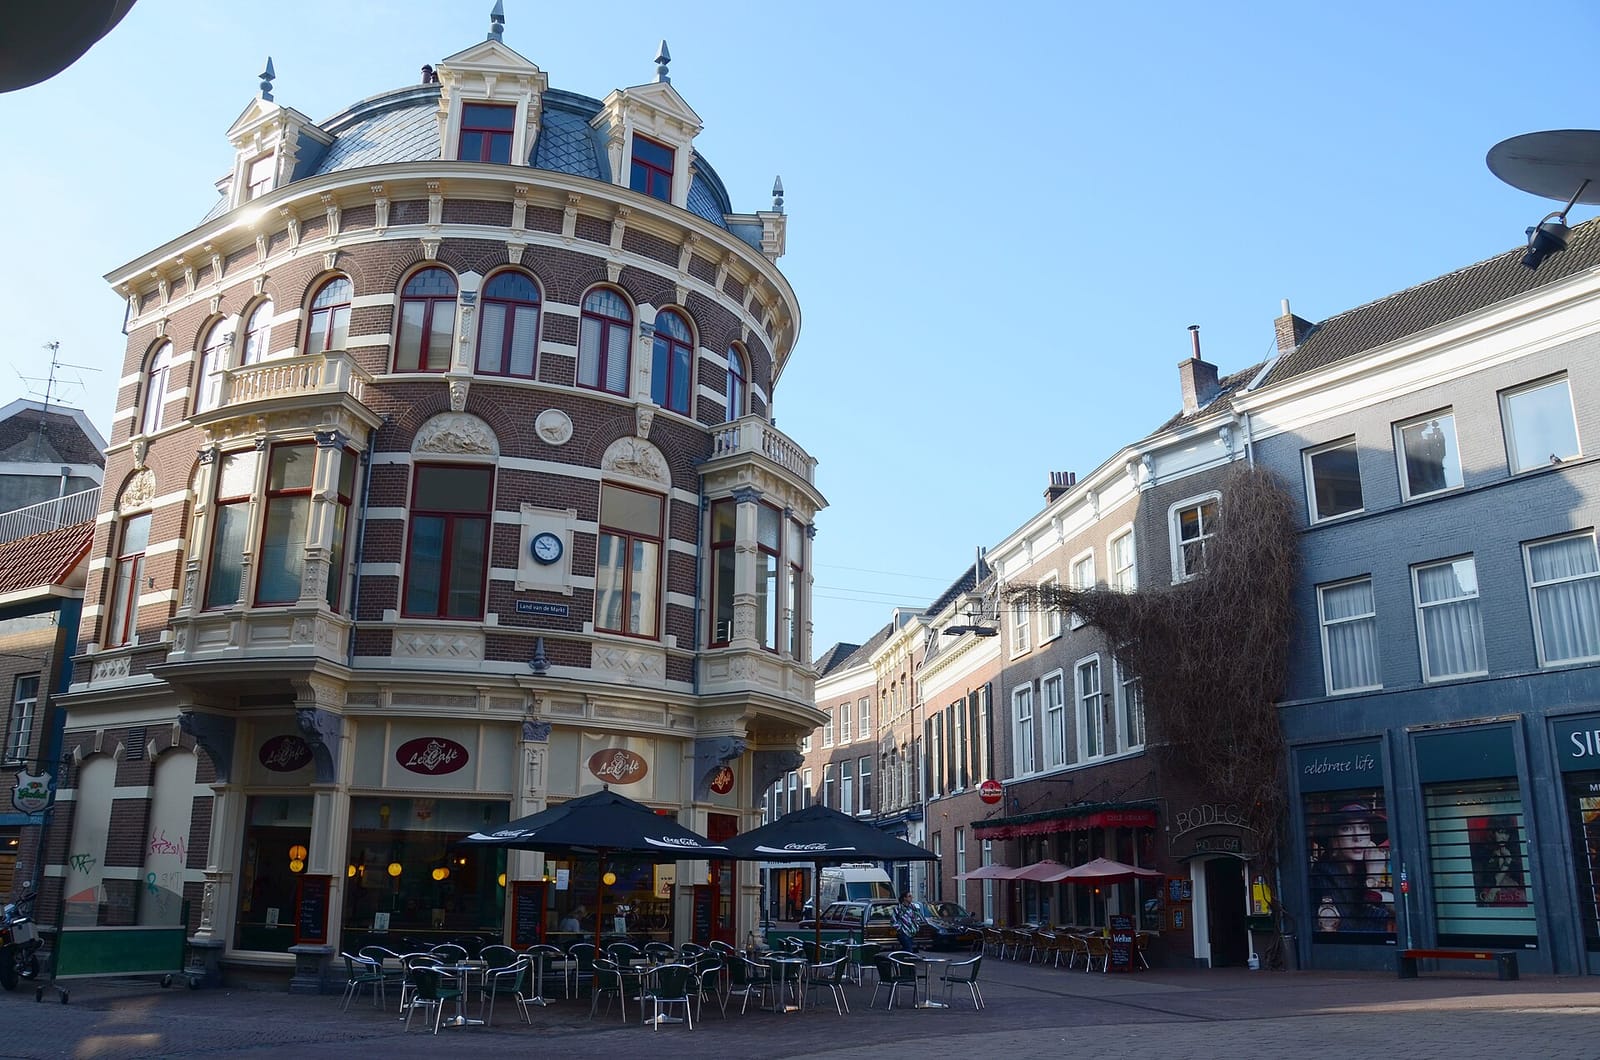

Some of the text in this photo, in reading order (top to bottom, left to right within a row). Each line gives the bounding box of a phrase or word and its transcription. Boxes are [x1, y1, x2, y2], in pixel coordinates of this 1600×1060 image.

[519, 602, 533, 610] Land
[405, 752, 426, 767] Le
[1304, 754, 1375, 775] celebrate life
[596, 762, 613, 775] Le
[784, 842, 827, 851] Coca-Cola
